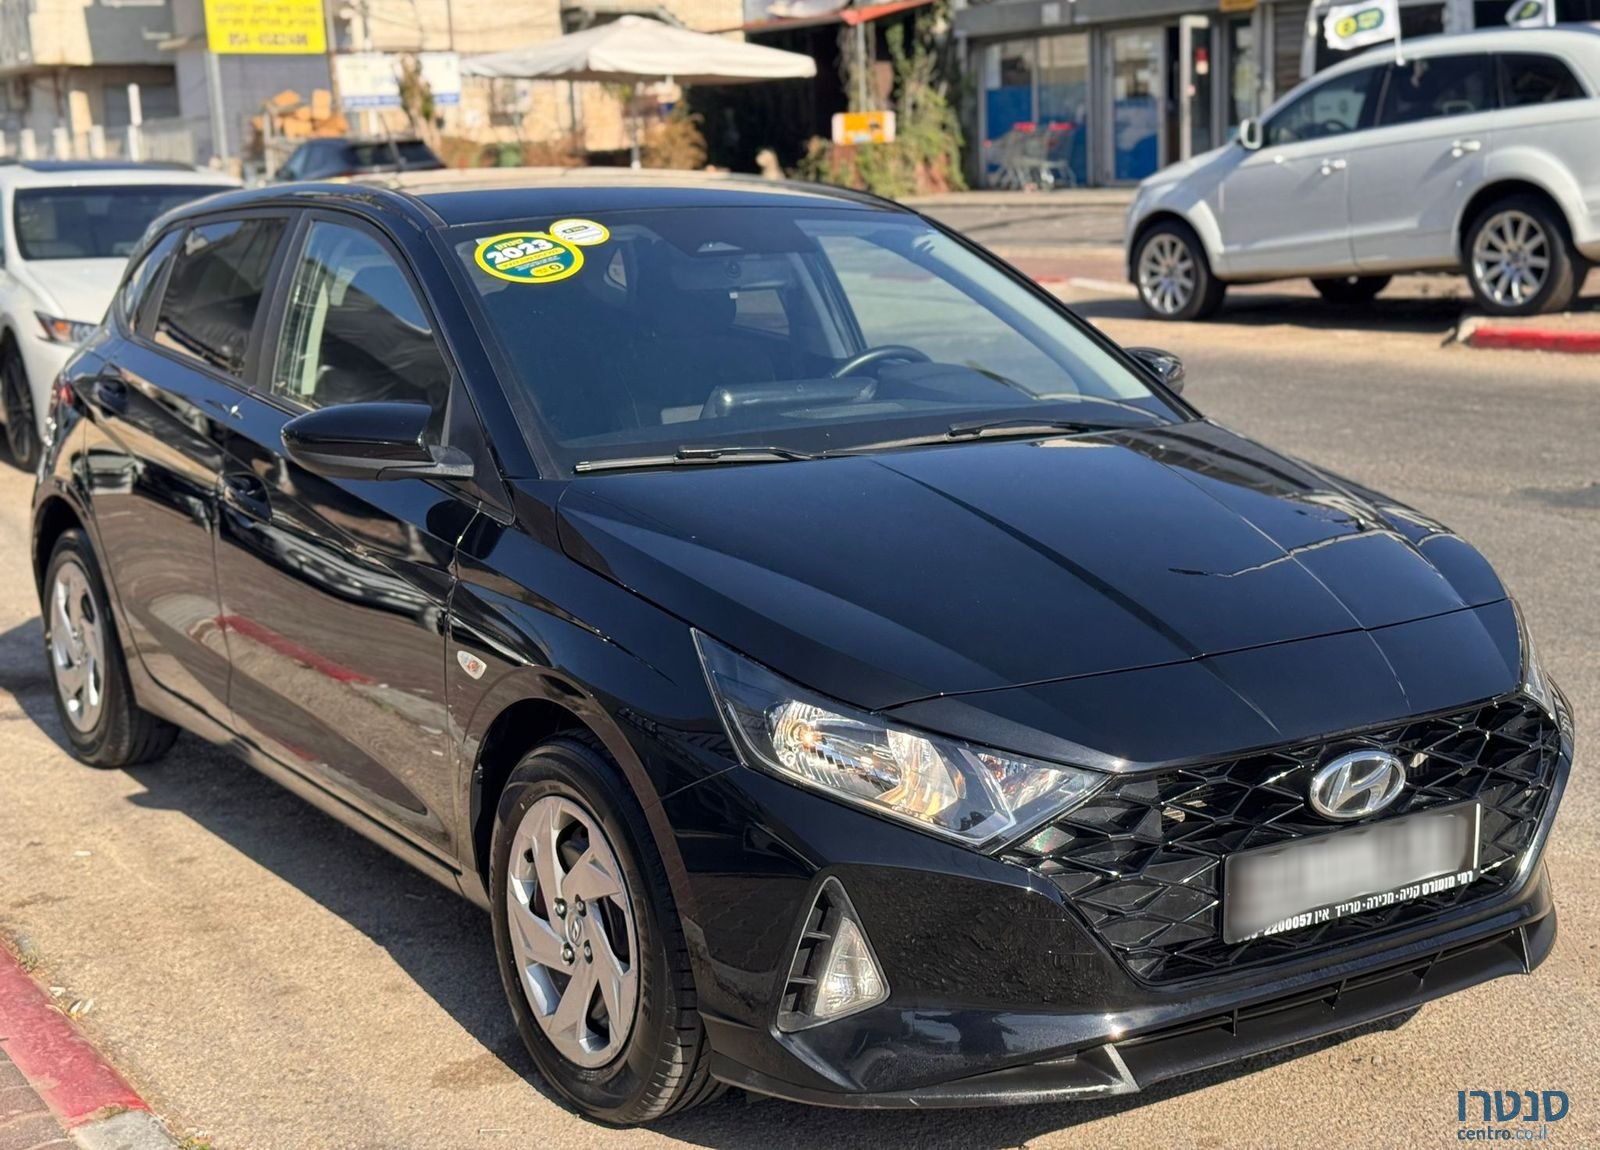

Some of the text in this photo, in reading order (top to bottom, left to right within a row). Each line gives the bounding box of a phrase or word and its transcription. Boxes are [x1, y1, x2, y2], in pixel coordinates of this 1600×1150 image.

[486, 239, 554, 265] 2023
[1422, 875, 1455, 895] מוטורס
[1457, 870, 1474, 885] רמי
[1314, 908, 1330, 924] אין
